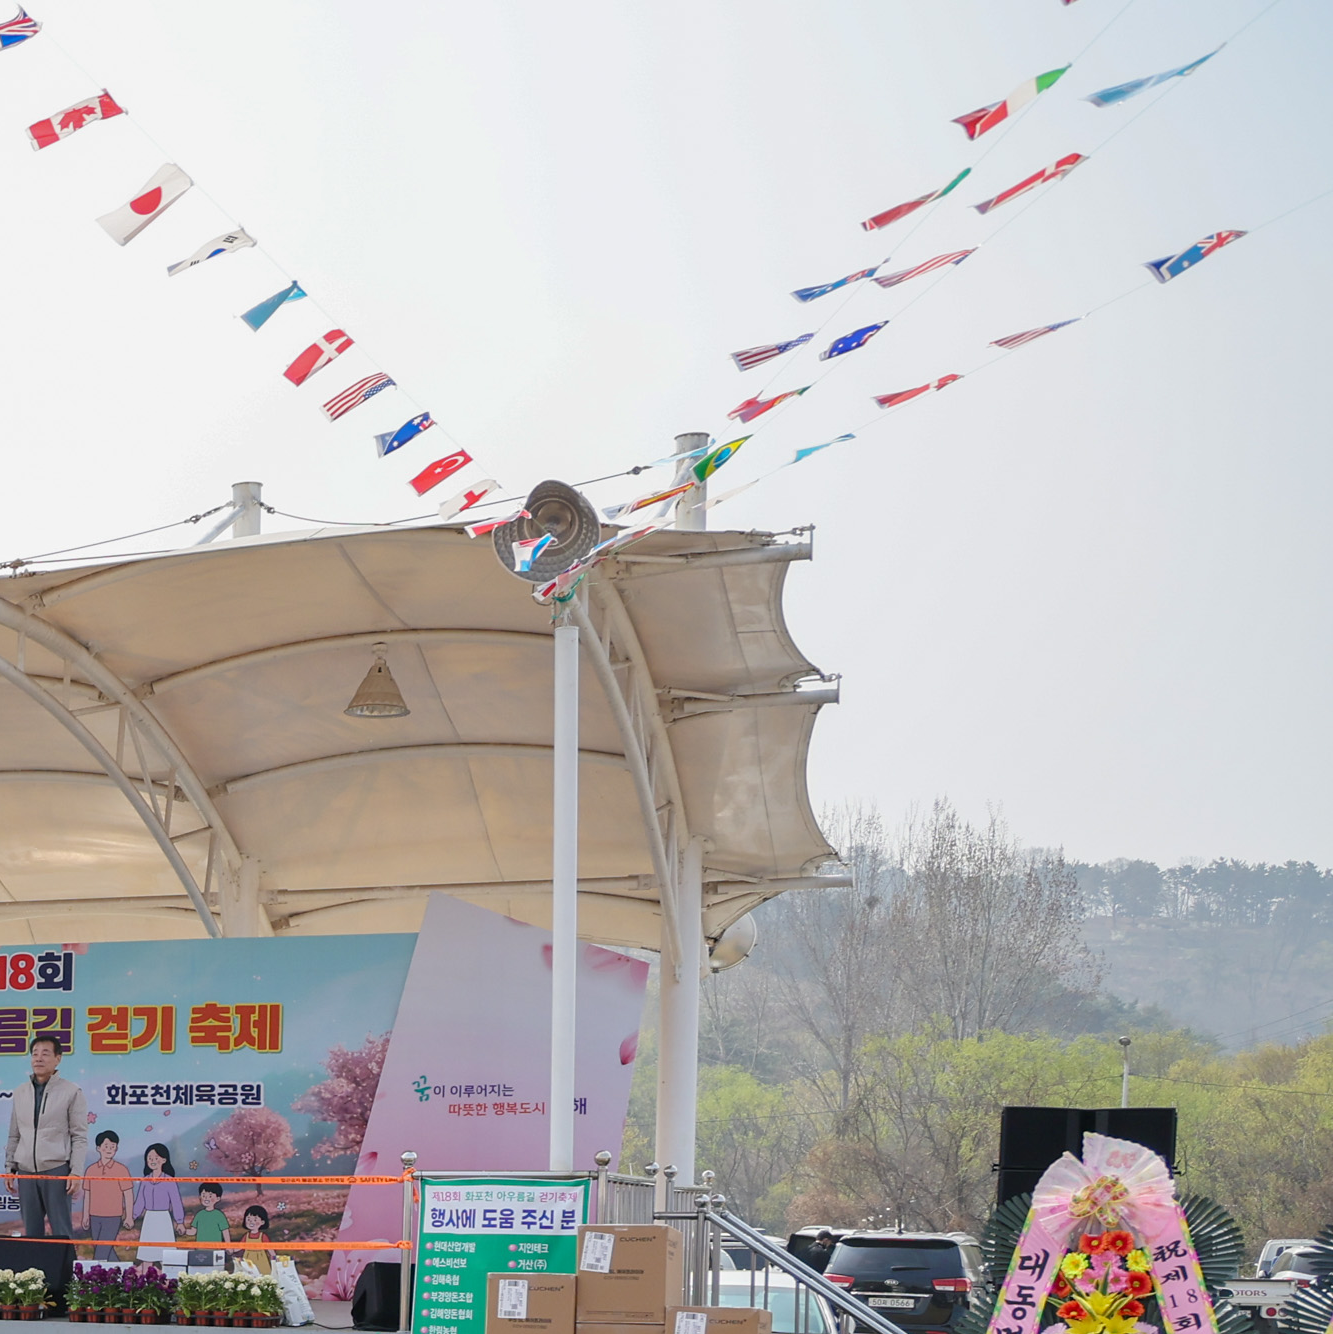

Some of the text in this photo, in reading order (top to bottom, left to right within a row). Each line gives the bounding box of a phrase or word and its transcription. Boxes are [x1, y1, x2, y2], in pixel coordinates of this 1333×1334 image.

[86, 1004, 174, 1053] 걷기
[188, 1002, 282, 1051] 축제
[105, 1082, 263, 1107] 화포천체육공원
[450, 1084, 515, 1098] 이루어지는
[448, 1098, 587, 1116] 따뜻한 행복도시 해
[432, 1191, 461, 1202] 제18회
[465, 1191, 494, 1202] 화포천
[496, 1191, 535, 1203] 아우름길
[431, 1207, 576, 1230] 행사에 도움 주신 분
[433, 1241, 476, 1253] 현대산업개발
[518, 1243, 549, 1254] 지인테크
[1153, 1240, 1188, 1263] 祝
[431, 1274, 460, 1286] 김해축협
[890, 1299, 911, 1307] 0566
[430, 1308, 473, 1320] 김해양돈협회
